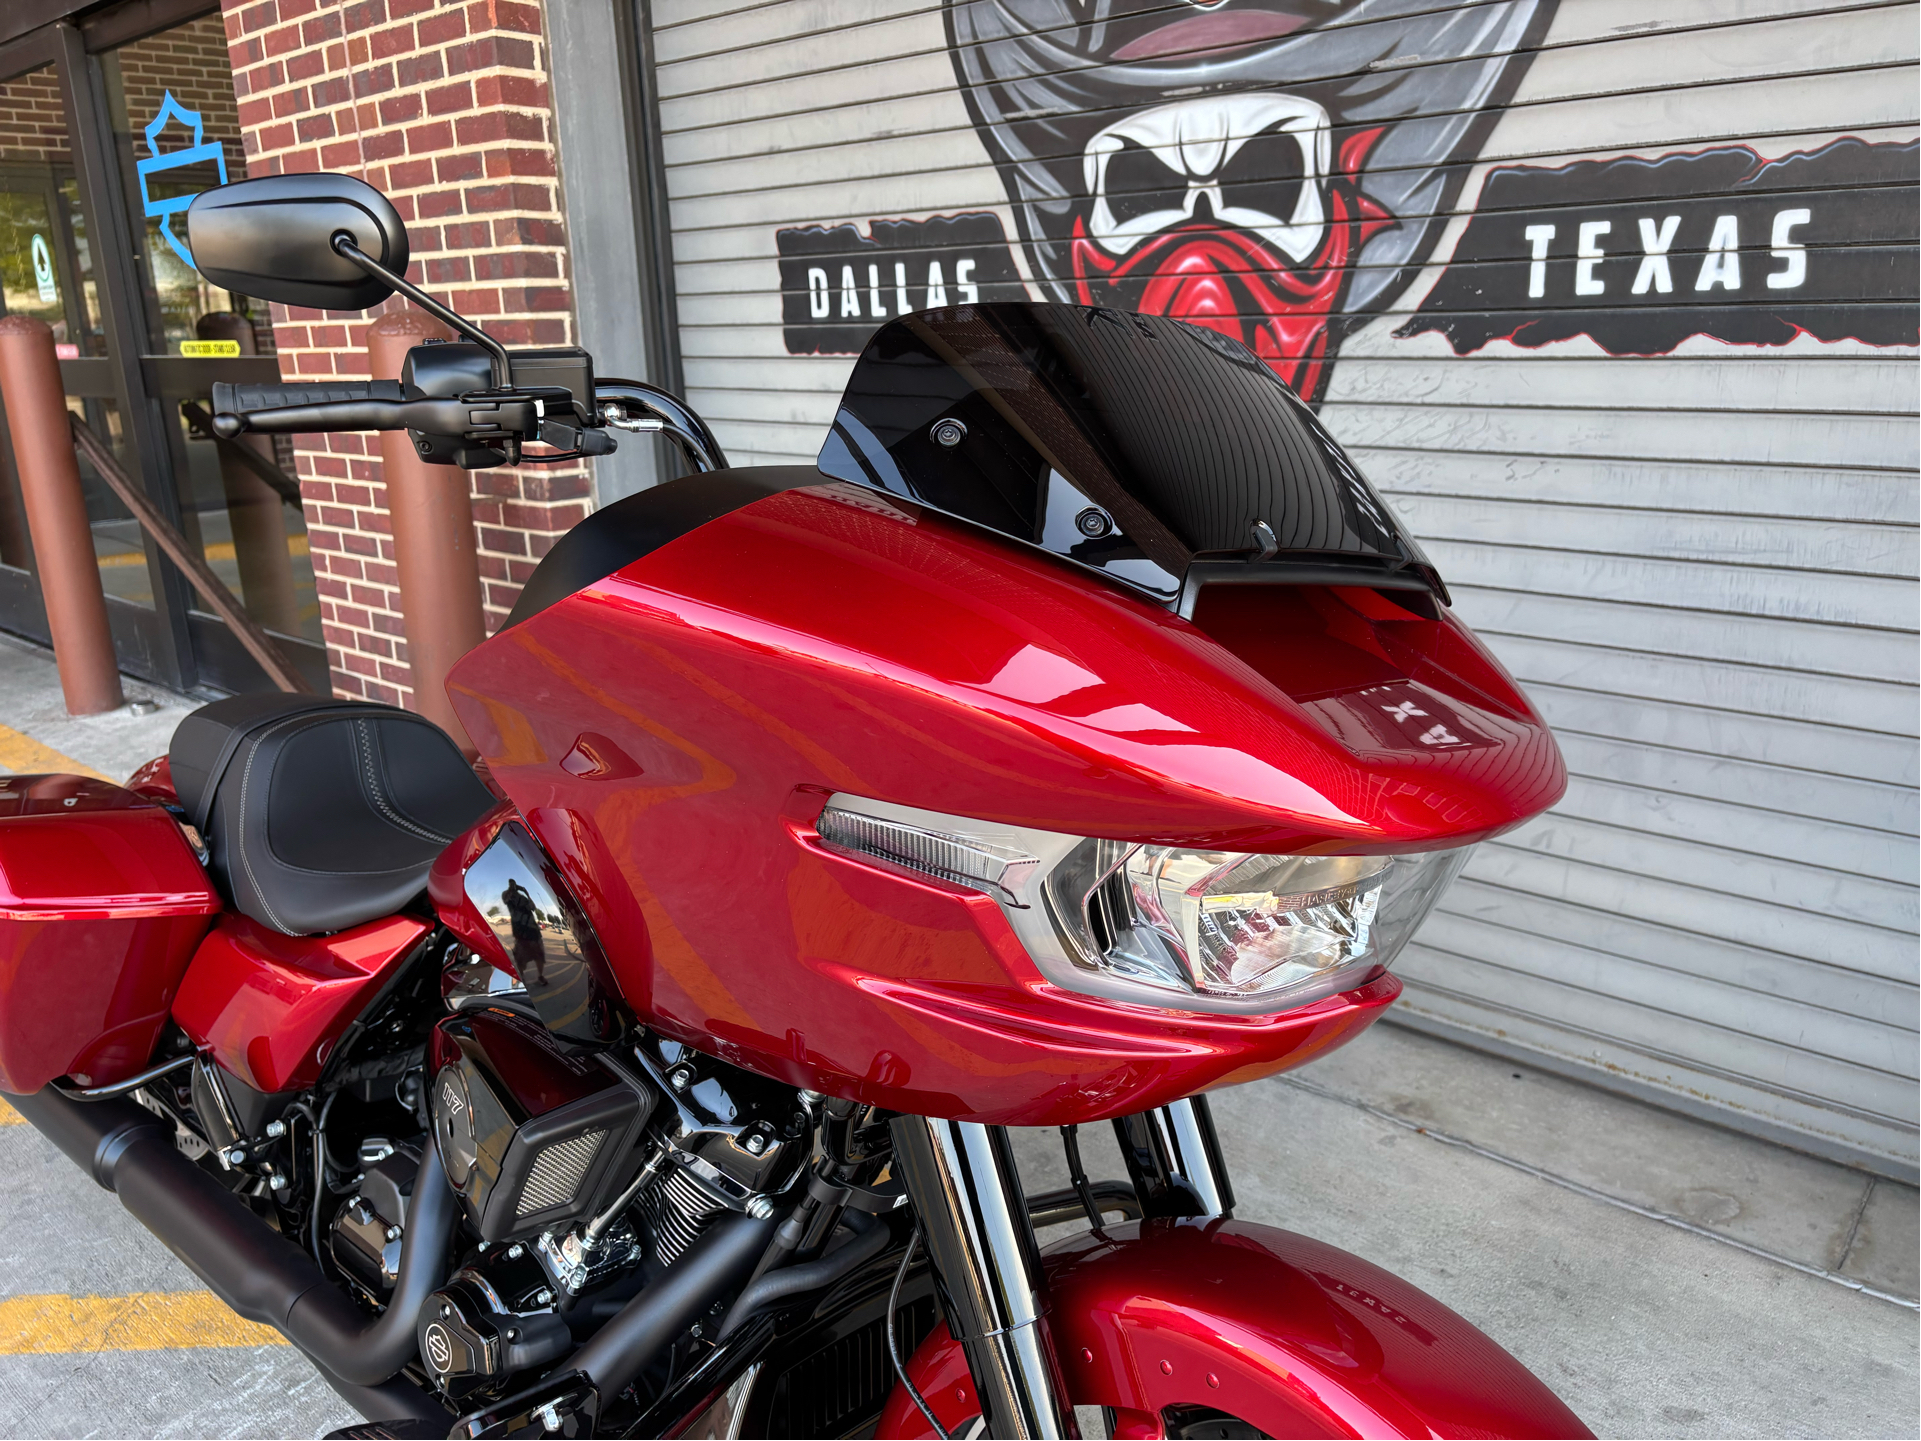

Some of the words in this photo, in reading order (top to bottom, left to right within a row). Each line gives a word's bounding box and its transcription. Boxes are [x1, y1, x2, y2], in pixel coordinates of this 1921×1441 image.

[1525, 208, 1811, 298] TEXAS
[808, 259, 979, 318] DALLAS
[442, 1082, 464, 1115] 117
